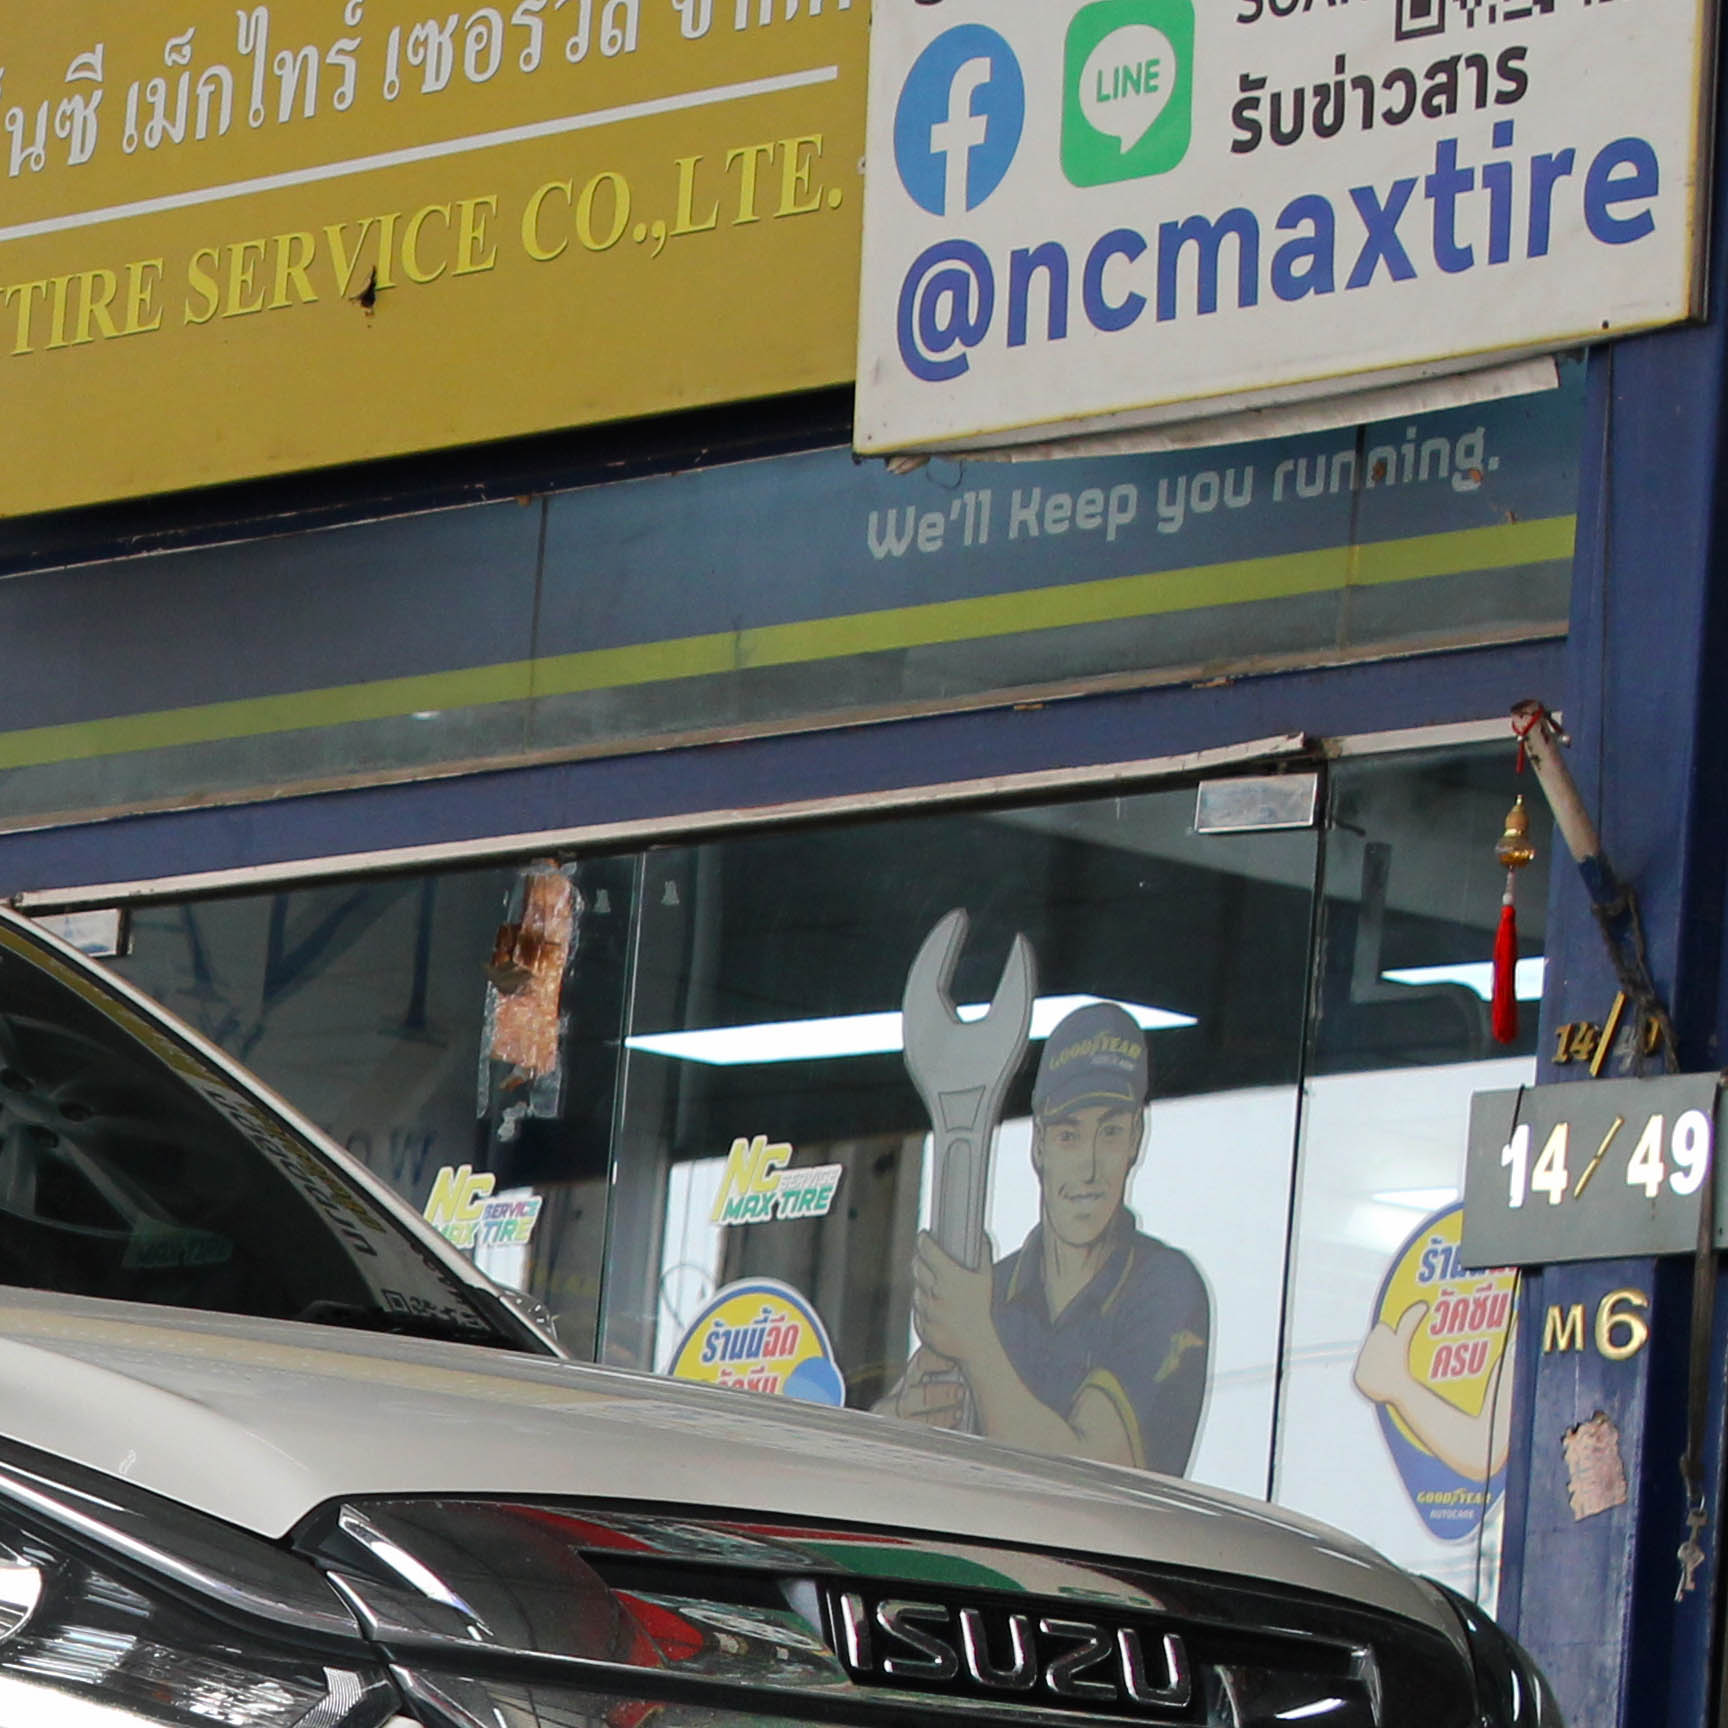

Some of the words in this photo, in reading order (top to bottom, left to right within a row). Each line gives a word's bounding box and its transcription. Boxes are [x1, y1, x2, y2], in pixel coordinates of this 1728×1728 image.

[1096, 57, 1161, 104] LINE
[1230, 46, 1529, 154] รับข่าวสาร
[182, 195, 500, 328] SERVICE
[896, 119, 1661, 384] @ncmaxtire
[867, 488, 992, 561] We'll
[1156, 460, 1255, 534] you
[1272, 425, 1502, 505] running.
[425, 1167, 494, 1222] NC
[712, 1136, 792, 1222] NC
[723, 1194, 774, 1222] MAX
[780, 1185, 834, 1212] TIRE
[485, 1218, 533, 1241] TIRE
[1428, 1283, 1510, 1337] วัคซีน
[1429, 1340, 1490, 1380] ครบ
[840, 1592, 1191, 1708] ISUZU
